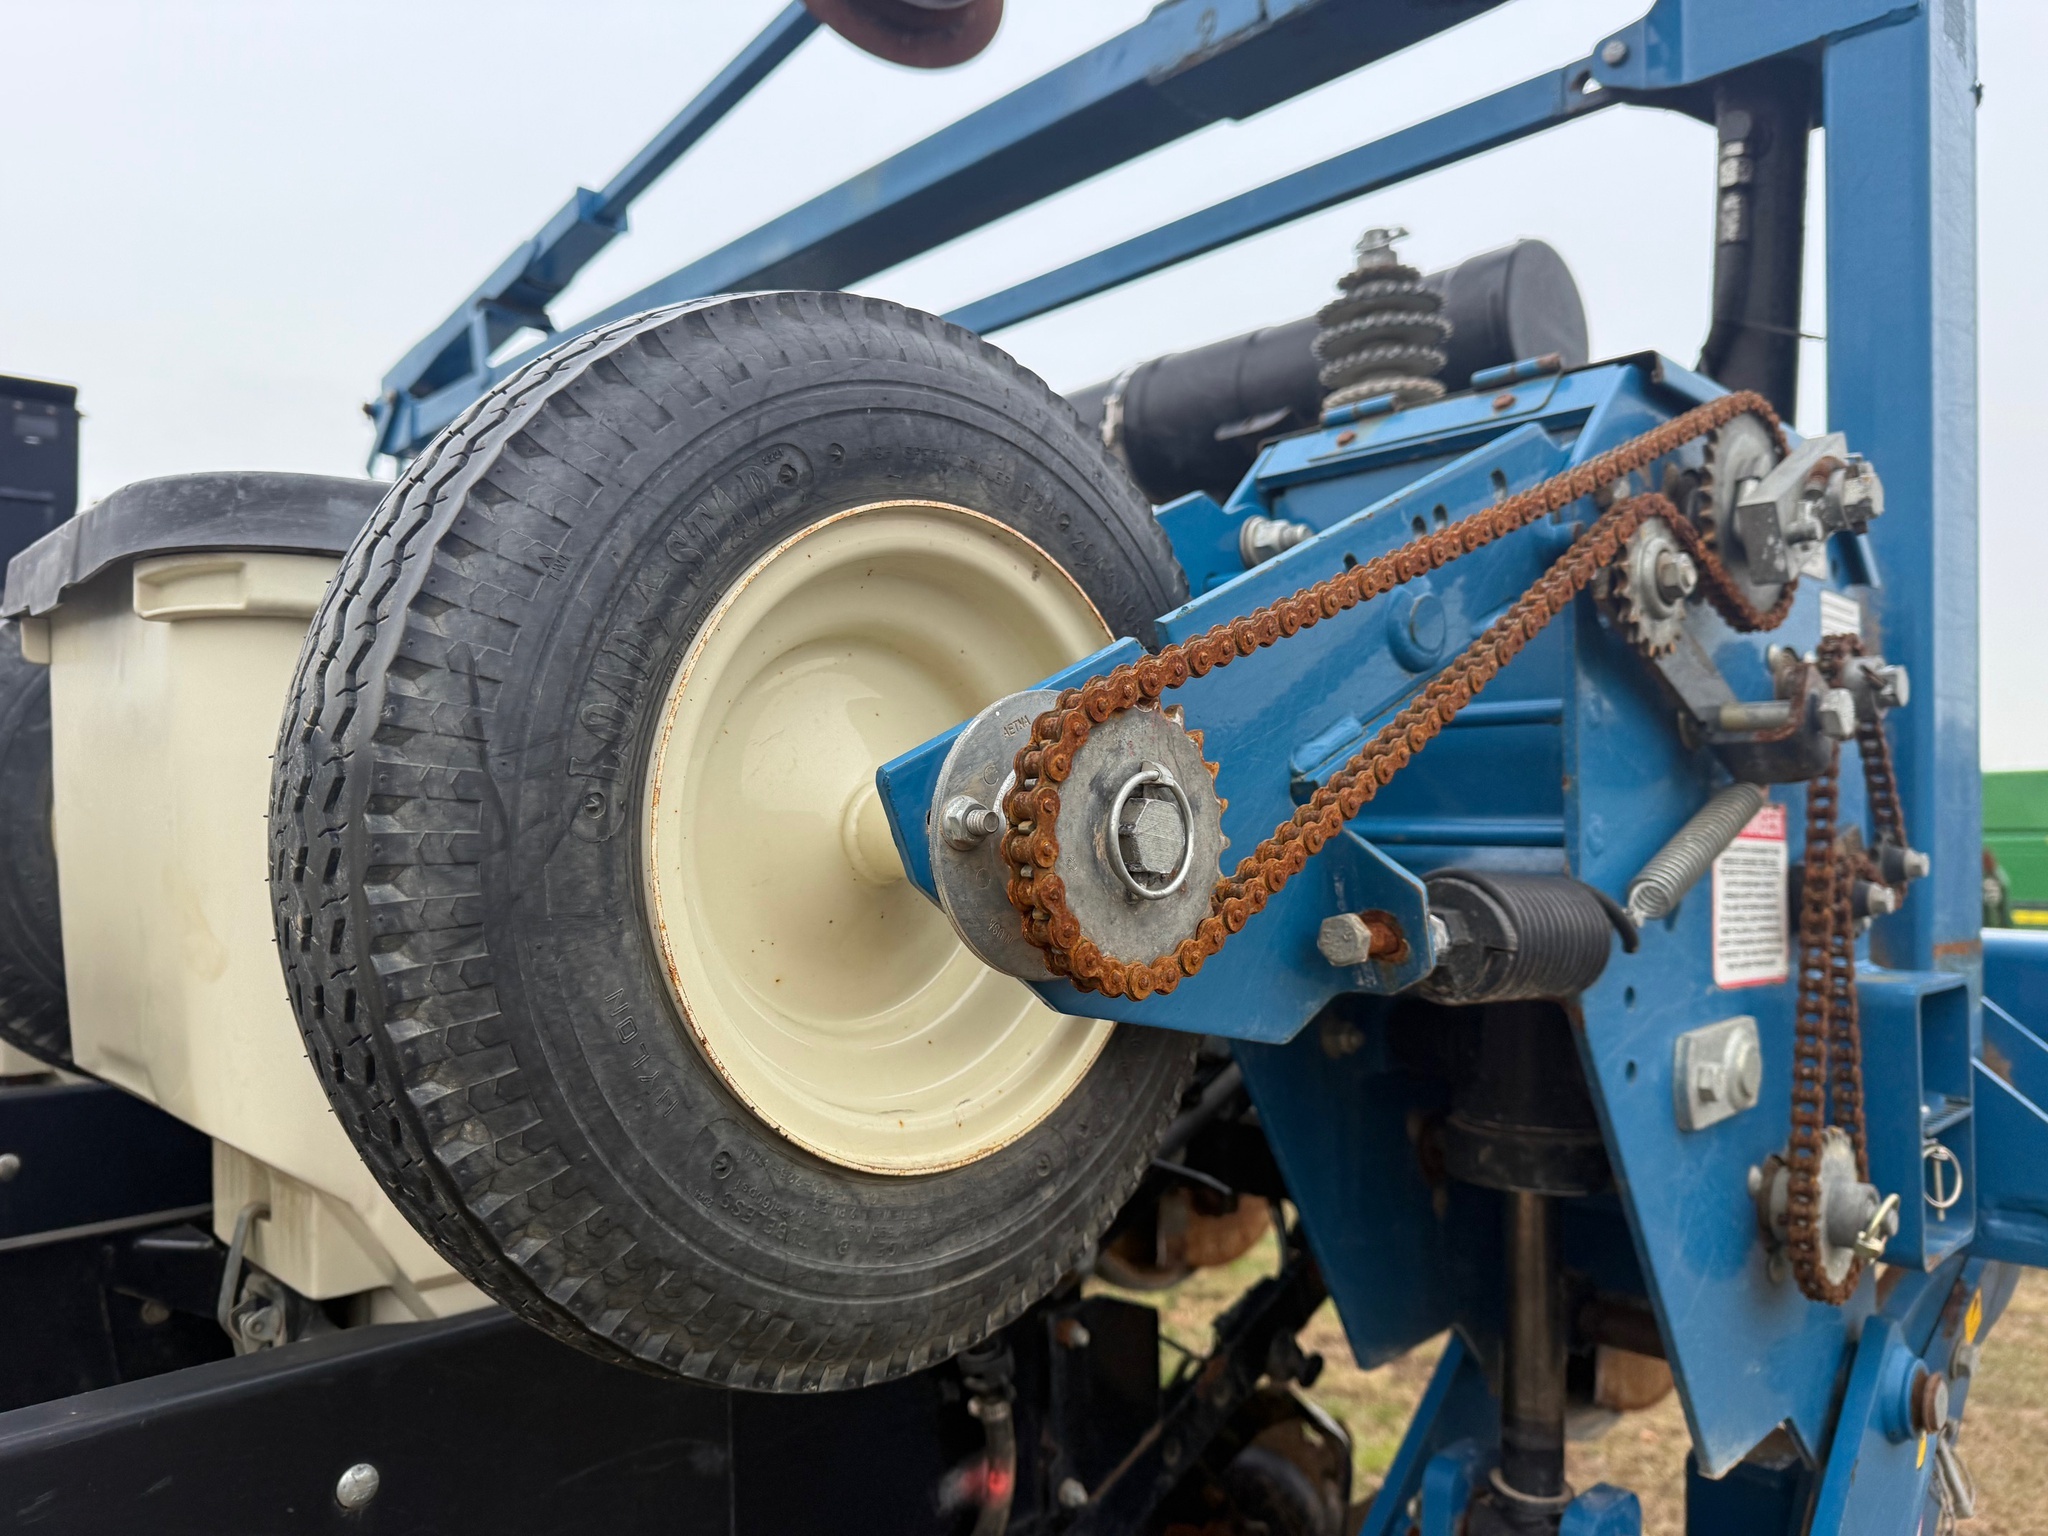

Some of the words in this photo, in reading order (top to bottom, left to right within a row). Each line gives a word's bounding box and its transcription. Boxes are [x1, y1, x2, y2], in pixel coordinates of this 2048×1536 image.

[547, 554, 573, 582] TWI
[568, 629, 655, 785] LOAD
[665, 465, 784, 588] STAR
[685, 626, 698, 643] IN
[696, 591, 722, 625] CHINA
[1002, 714, 1031, 738] AETNA
[988, 918, 1005, 940] USA
